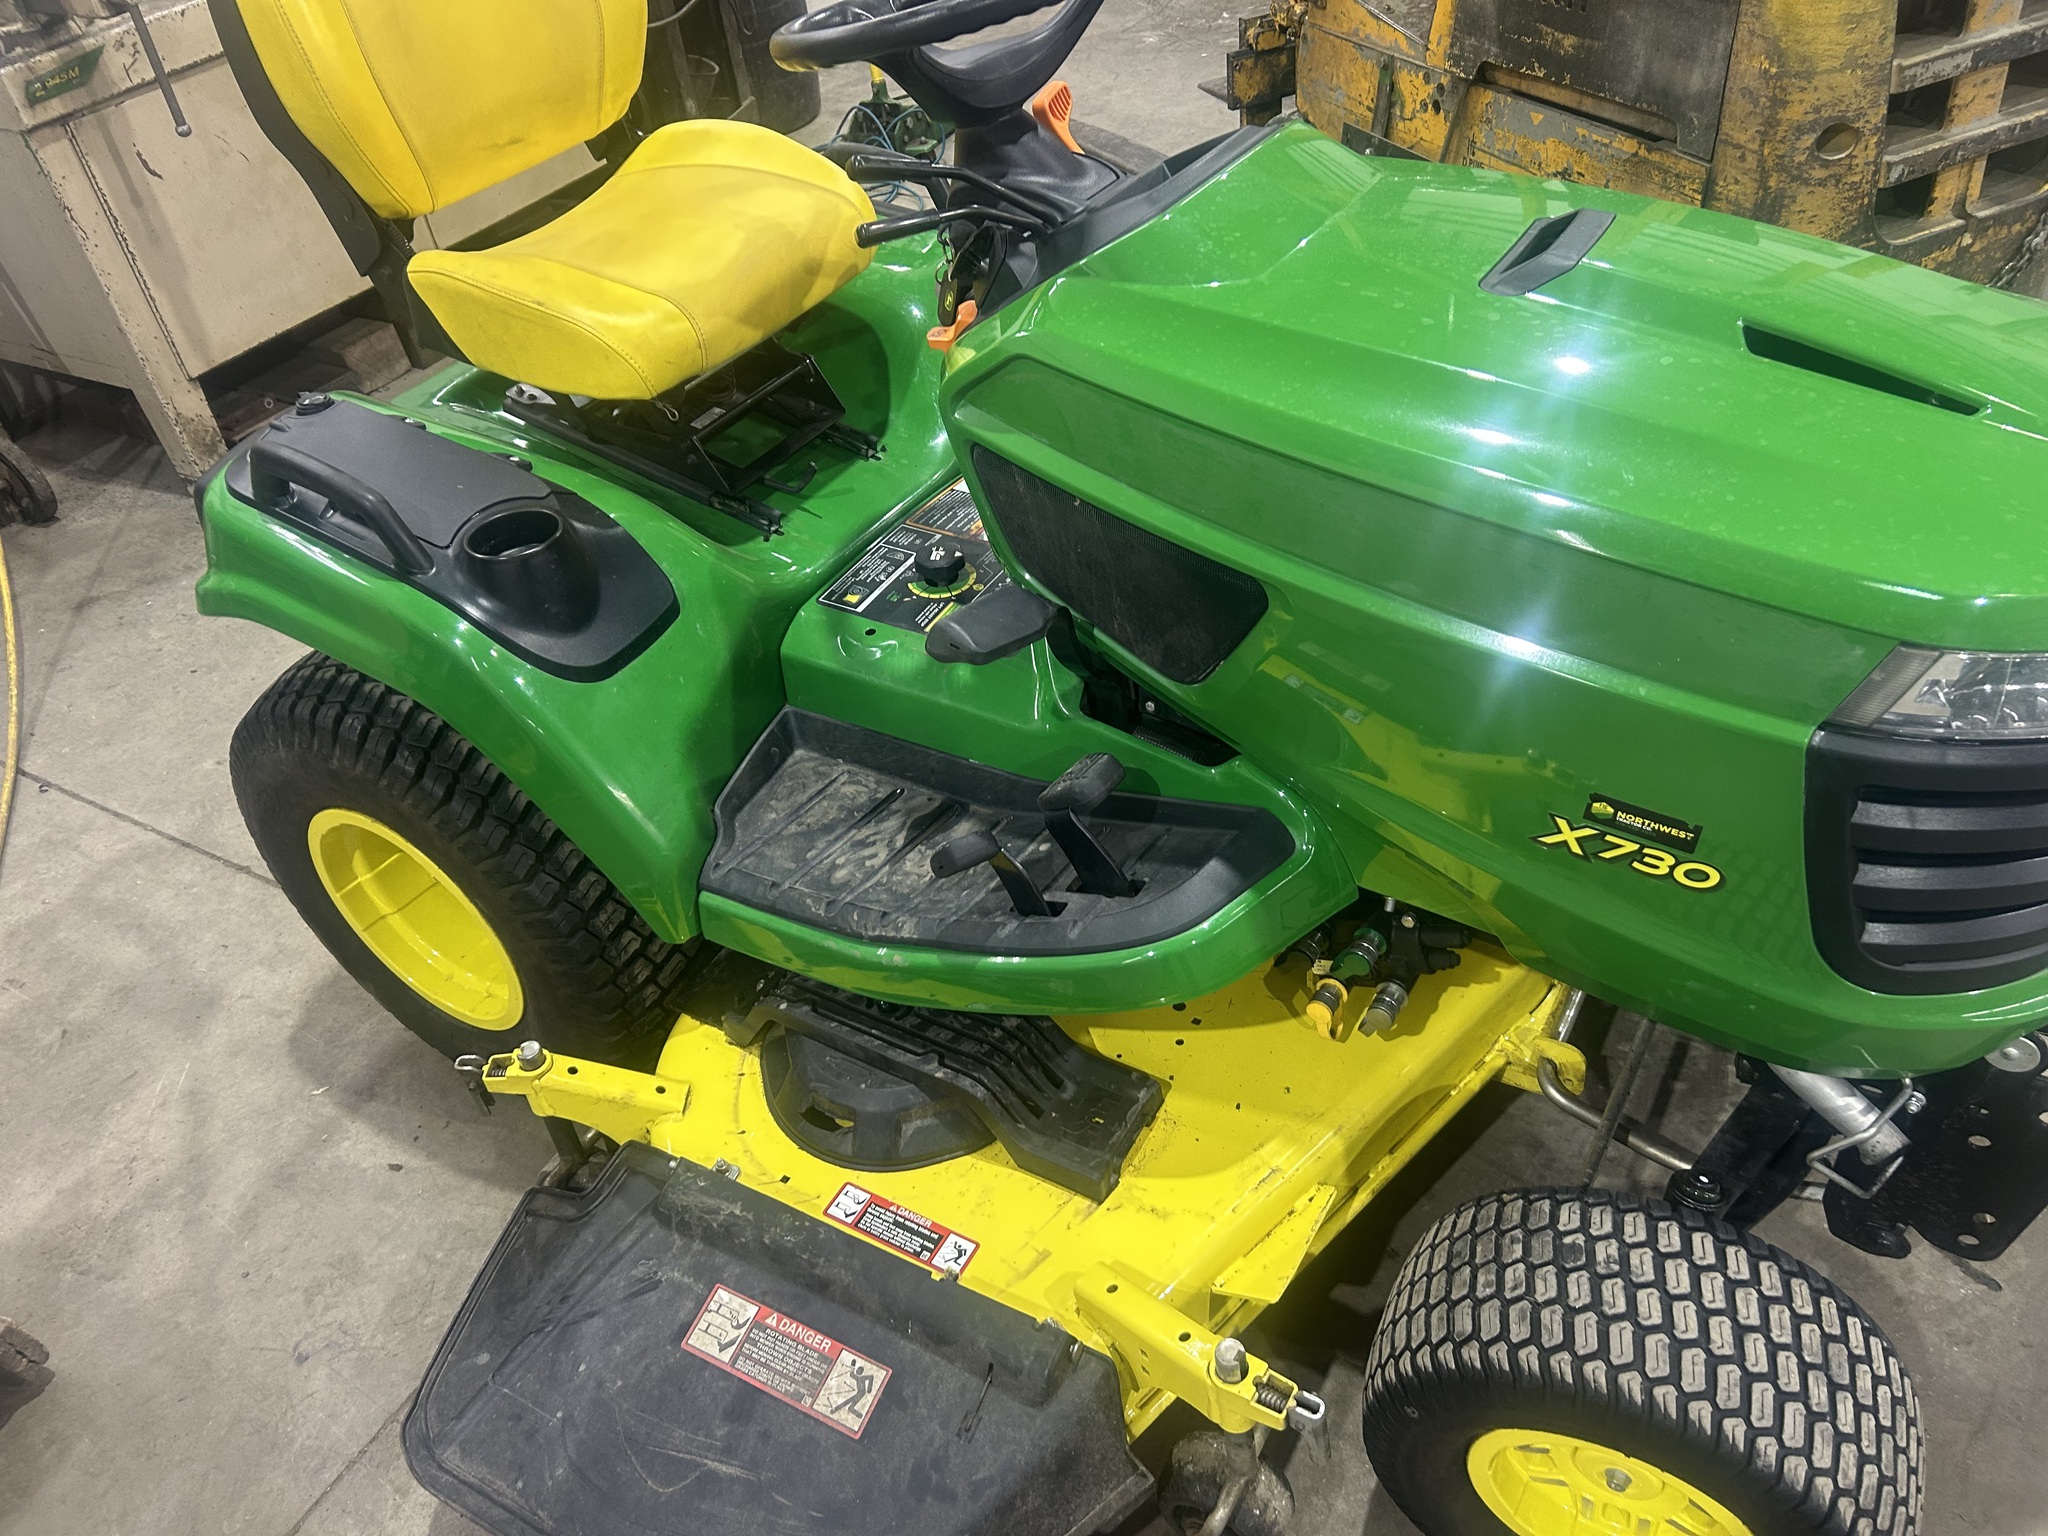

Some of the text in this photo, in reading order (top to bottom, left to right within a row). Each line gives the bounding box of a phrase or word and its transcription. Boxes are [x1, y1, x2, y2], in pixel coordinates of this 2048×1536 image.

[1616, 817, 1642, 828] TRACTOR
[1616, 810, 1695, 840] NORTHWEST
[1536, 815, 1721, 889] X730
[898, 1206, 933, 1229] DANGER
[765, 1328, 819, 1359] ROTATING BLADE
[779, 1318, 832, 1353] DANGER
[756, 1342, 813, 1375] THROWN OBJECTS
